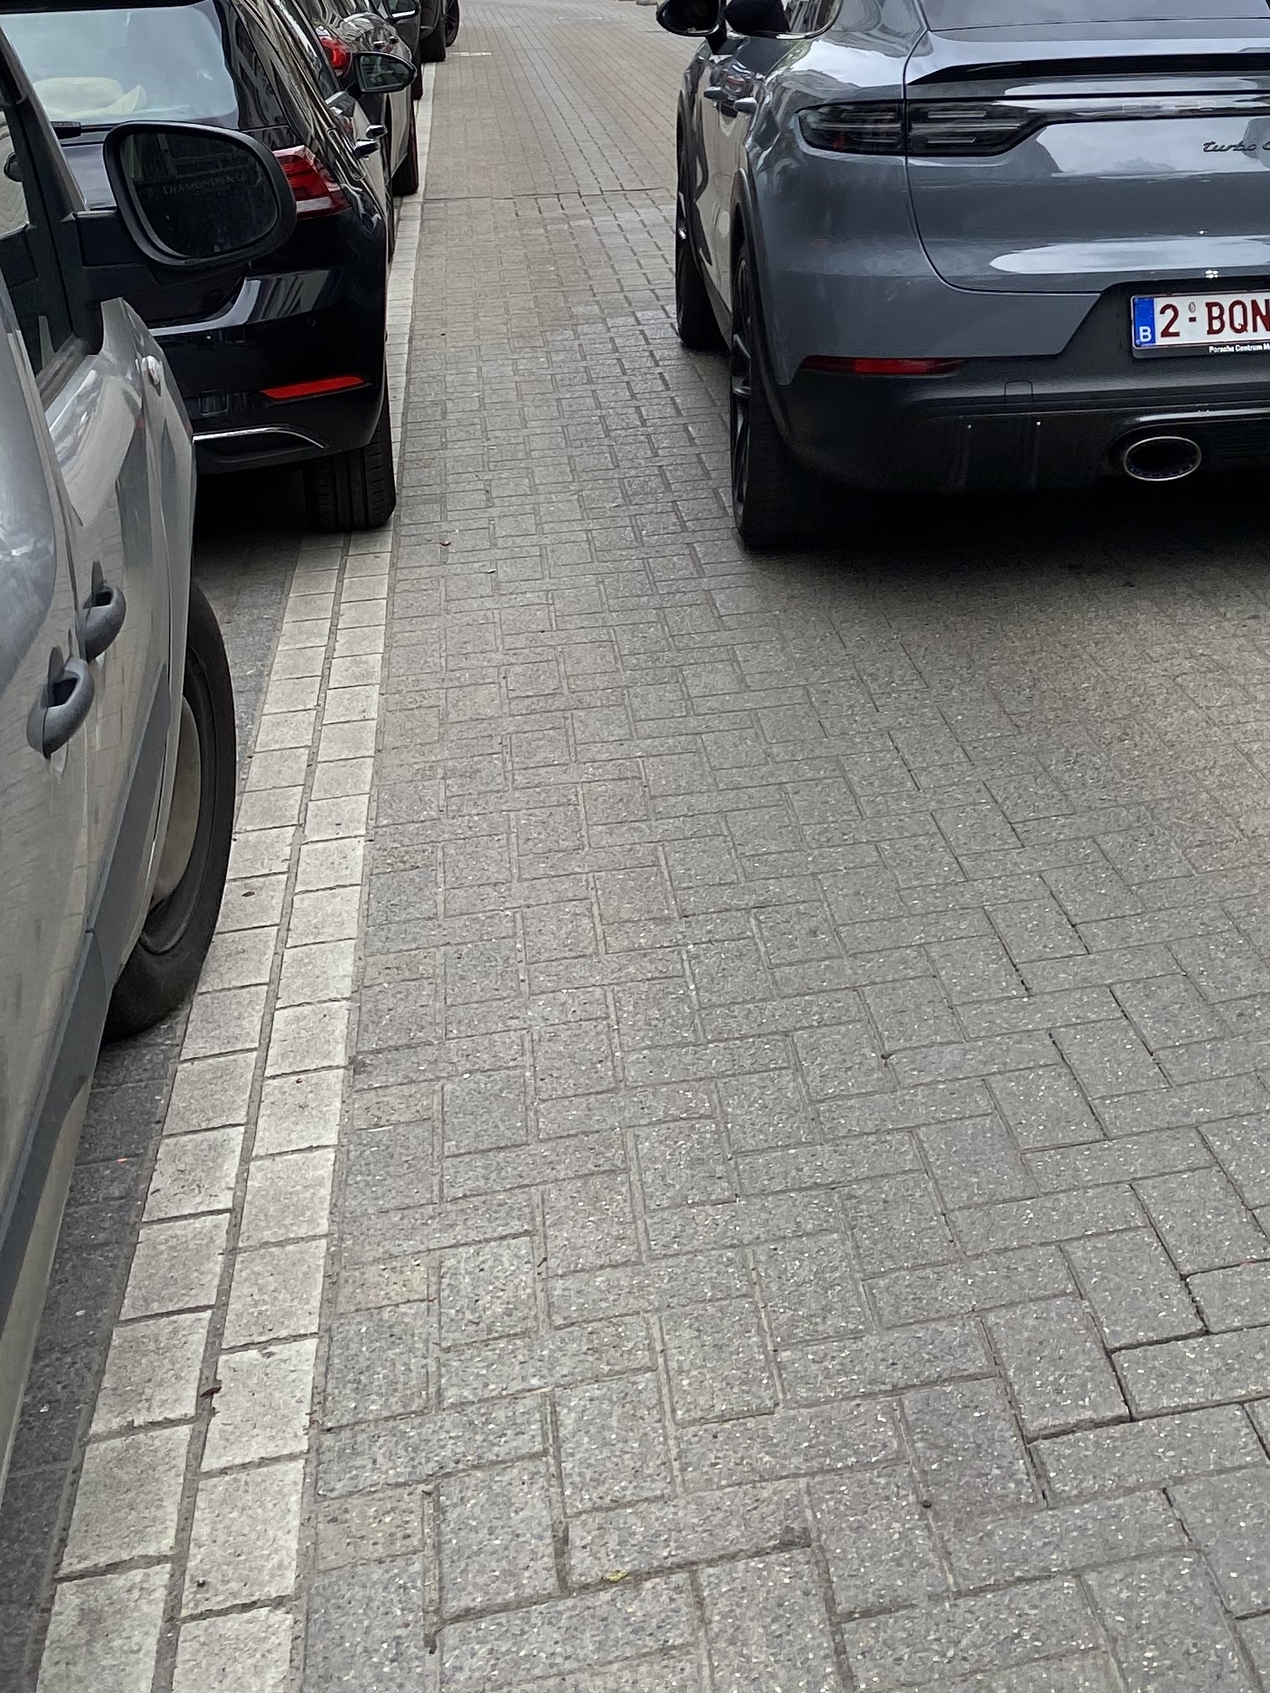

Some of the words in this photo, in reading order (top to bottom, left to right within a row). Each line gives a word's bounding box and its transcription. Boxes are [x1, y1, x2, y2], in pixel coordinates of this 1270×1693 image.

[1203, 140, 1257, 153] turbo
[1138, 325, 1152, 343] B
[1208, 345, 1235, 354] Porsche
[1235, 343, 1263, 352] Centrum
